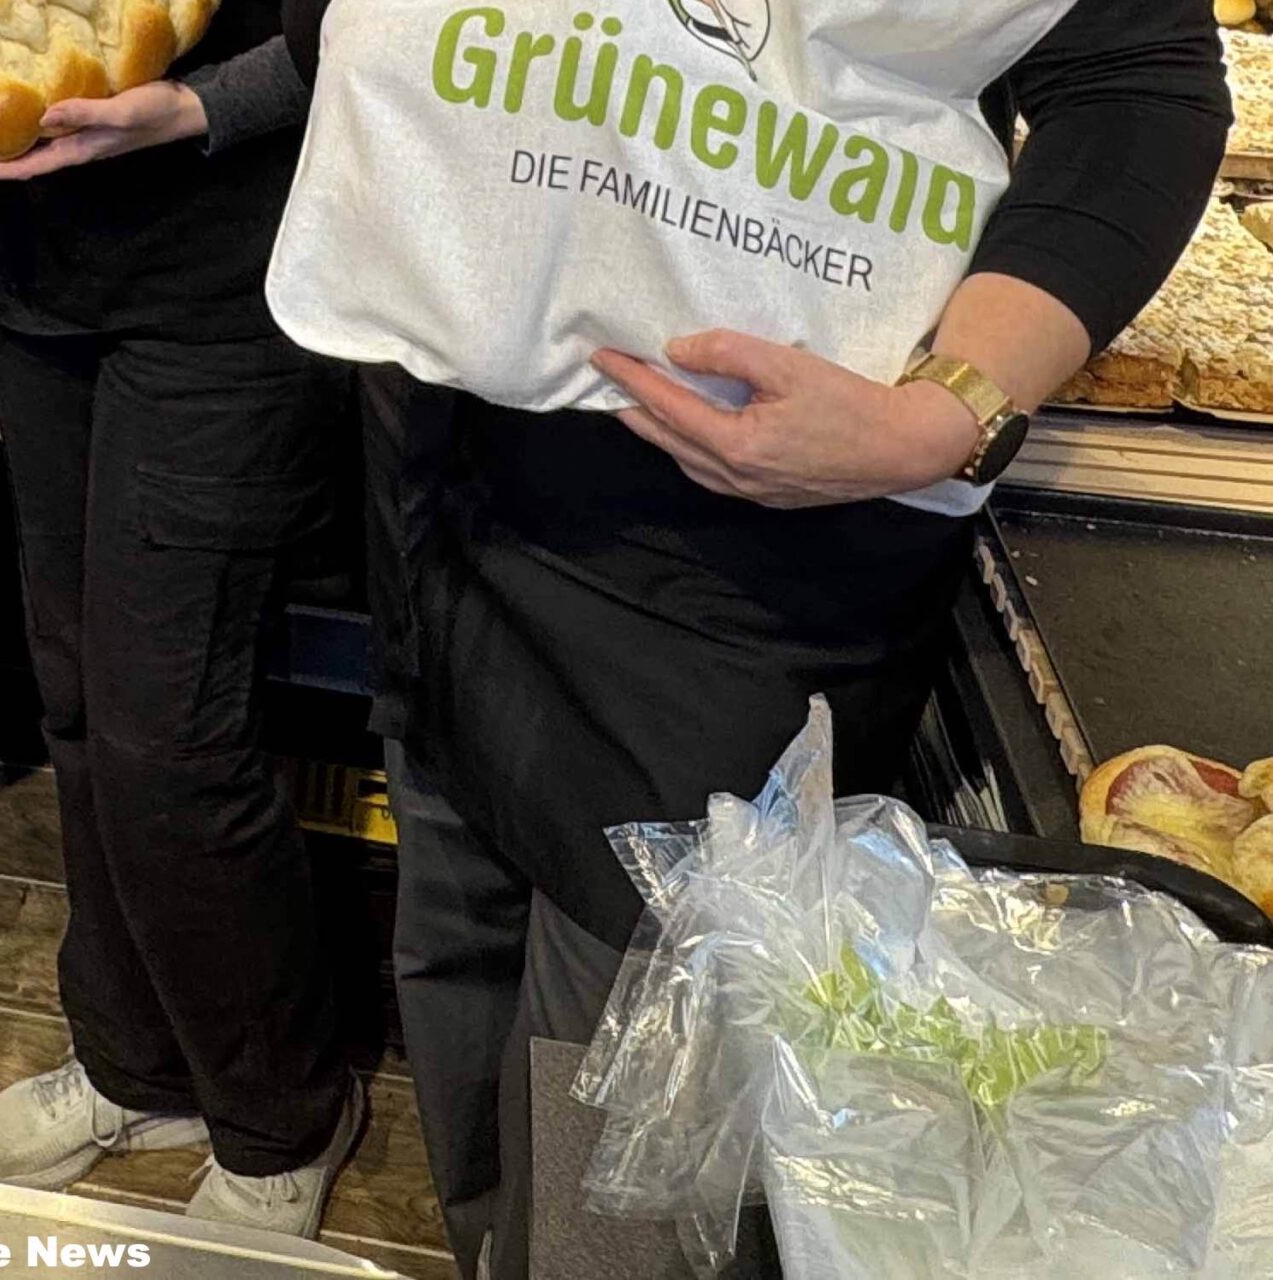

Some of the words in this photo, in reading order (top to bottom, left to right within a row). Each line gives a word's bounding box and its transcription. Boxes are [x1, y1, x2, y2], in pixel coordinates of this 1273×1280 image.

[431, 5, 977, 253] Grünewald
[510, 149, 573, 191] DIE
[579, 159, 874, 292] FAMILIENBÄCKER
